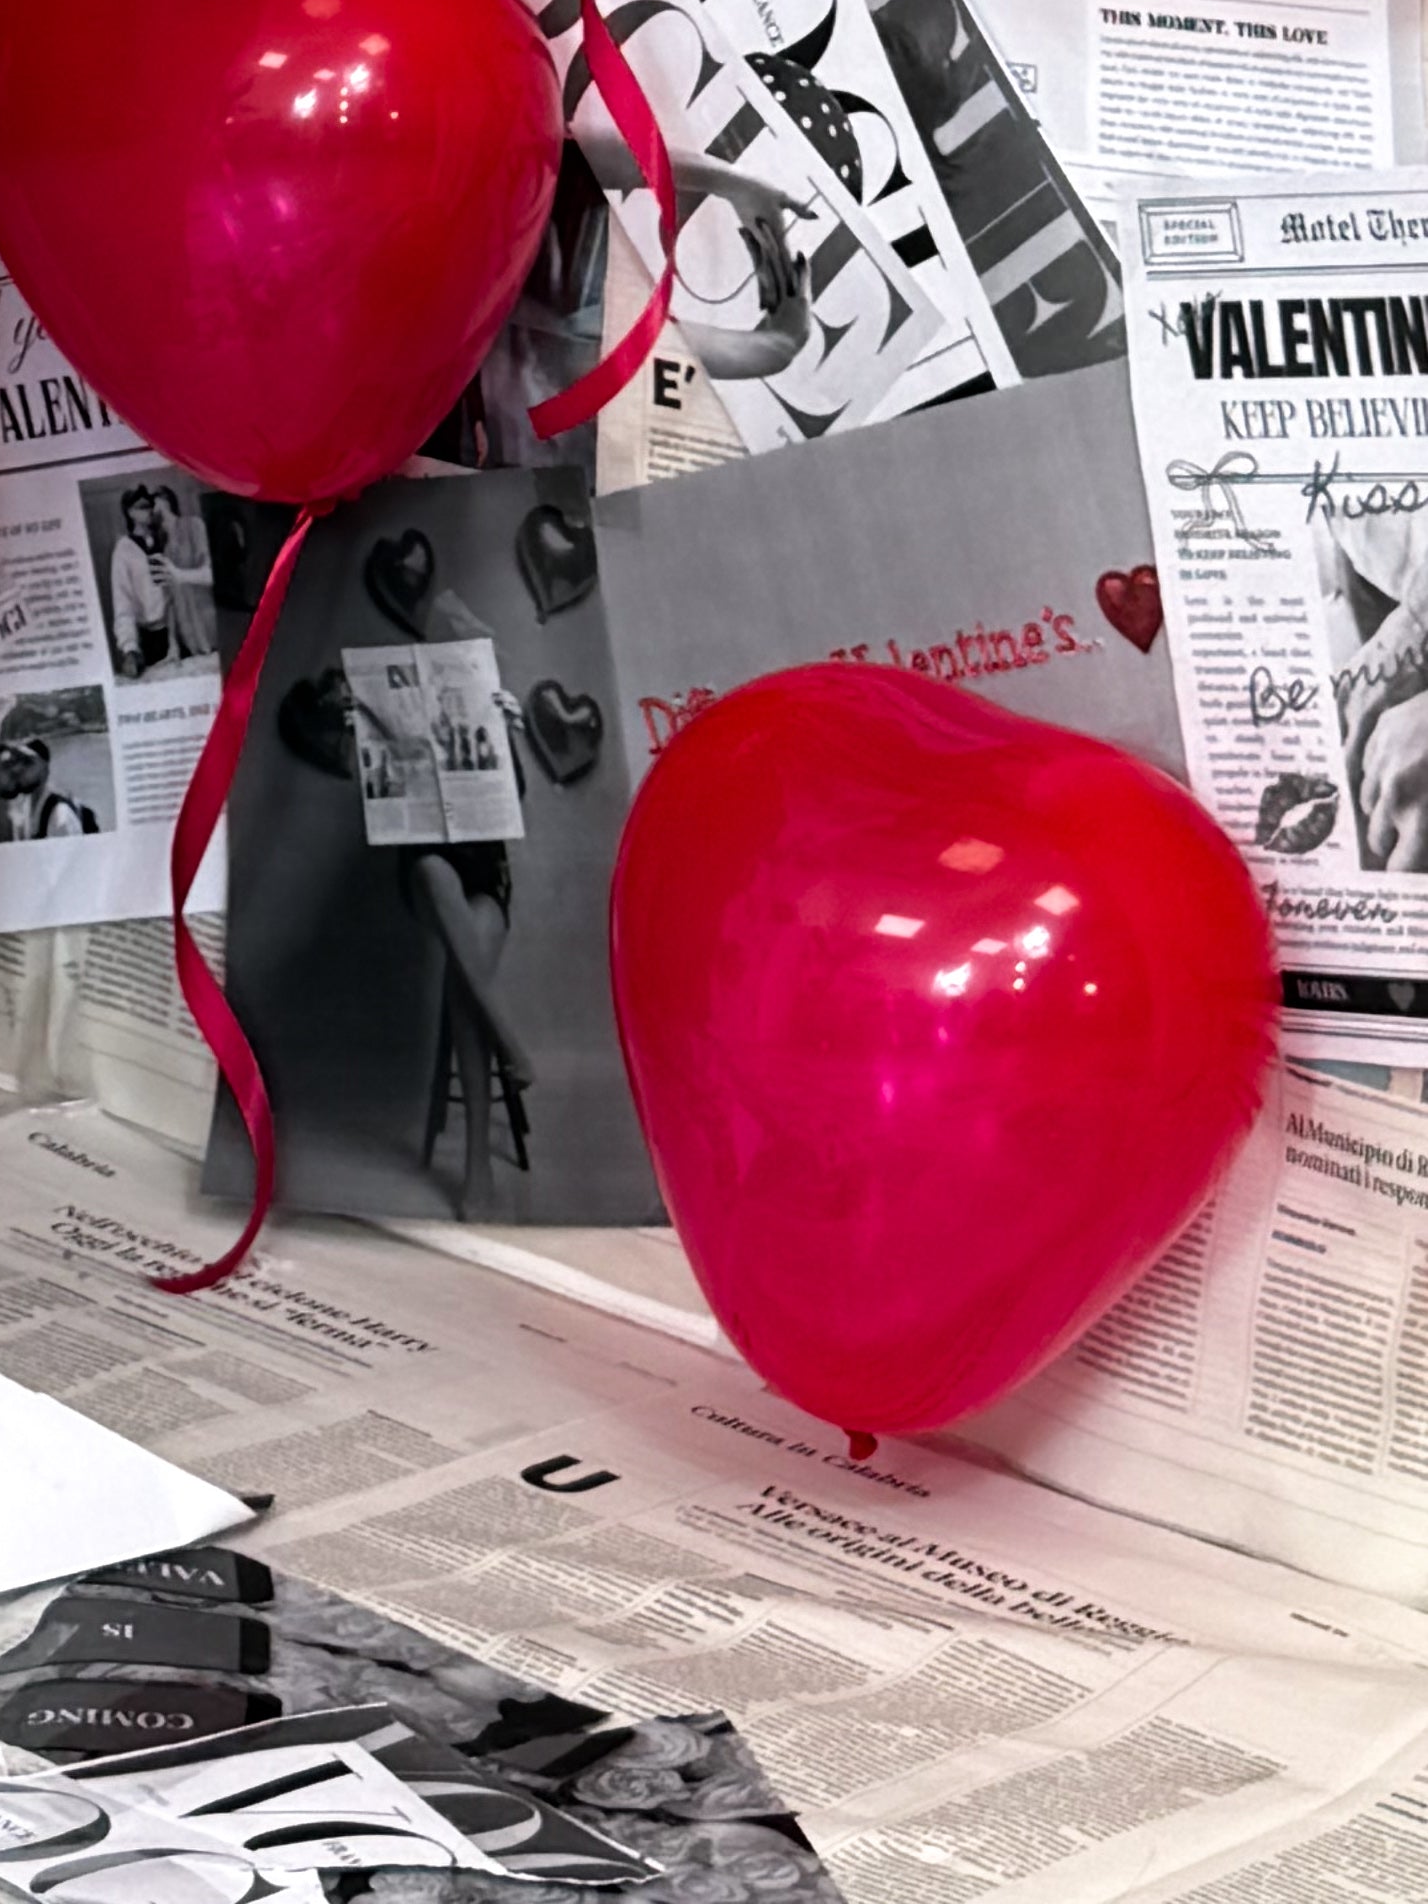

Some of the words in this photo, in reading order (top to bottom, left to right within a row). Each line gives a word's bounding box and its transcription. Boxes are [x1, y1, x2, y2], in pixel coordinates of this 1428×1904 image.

[1098, 6, 1143, 29] THIS
[1234, 20, 1278, 42] THIS
[1281, 25, 1329, 46] LOVE
[1280, 211, 1358, 245] Motel
[1219, 400, 1297, 440] KEEP
[688, 1403, 786, 1448] Cultura
[821, 1453, 933, 1501] Calabria
[757, 1484, 882, 1542] Versace
[917, 1541, 1029, 1590] Museo
[27, 1710, 197, 1732] COMING
